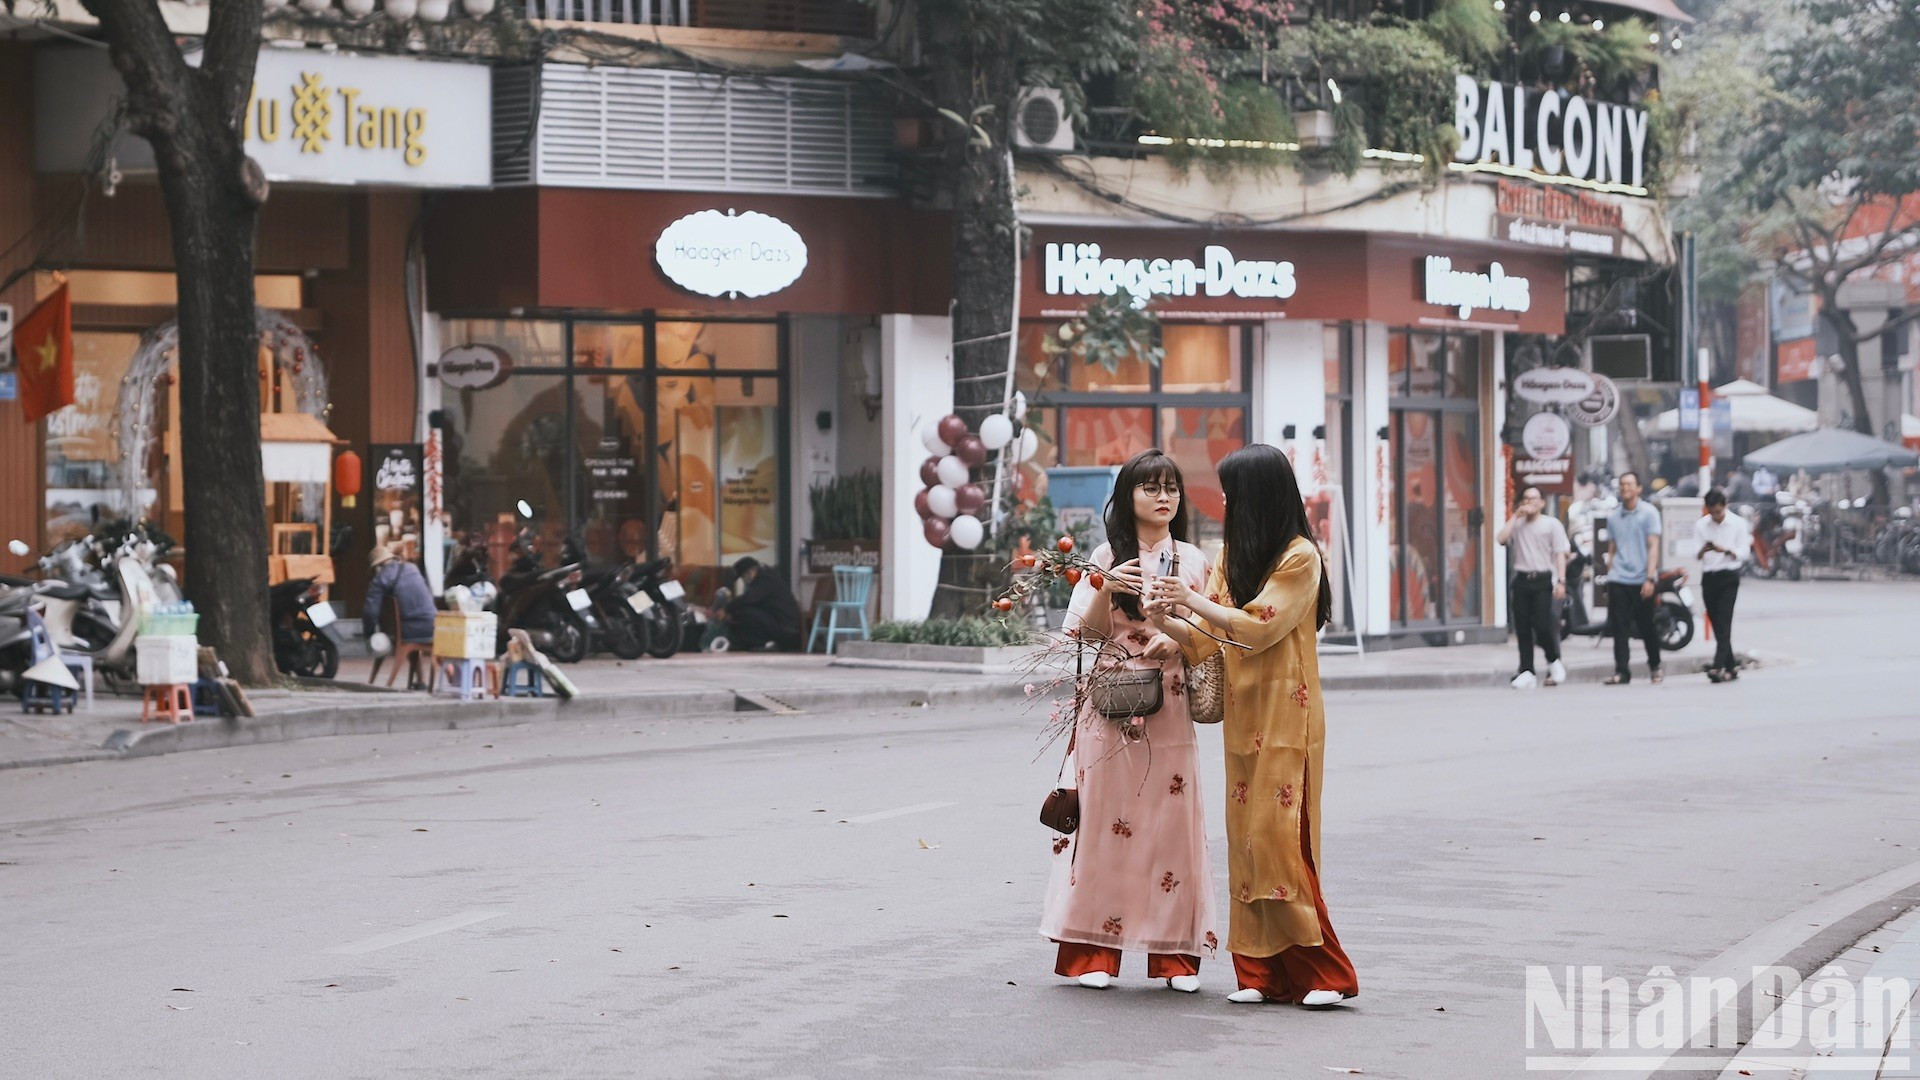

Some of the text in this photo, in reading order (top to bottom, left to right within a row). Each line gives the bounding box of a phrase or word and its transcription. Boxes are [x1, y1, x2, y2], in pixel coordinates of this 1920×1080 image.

[337, 86, 428, 167] Tang
[1454, 74, 1649, 188] BALCONY
[750, 241, 792, 262] Dazs
[1045, 242, 1297, 310] Häagen-Dazs
